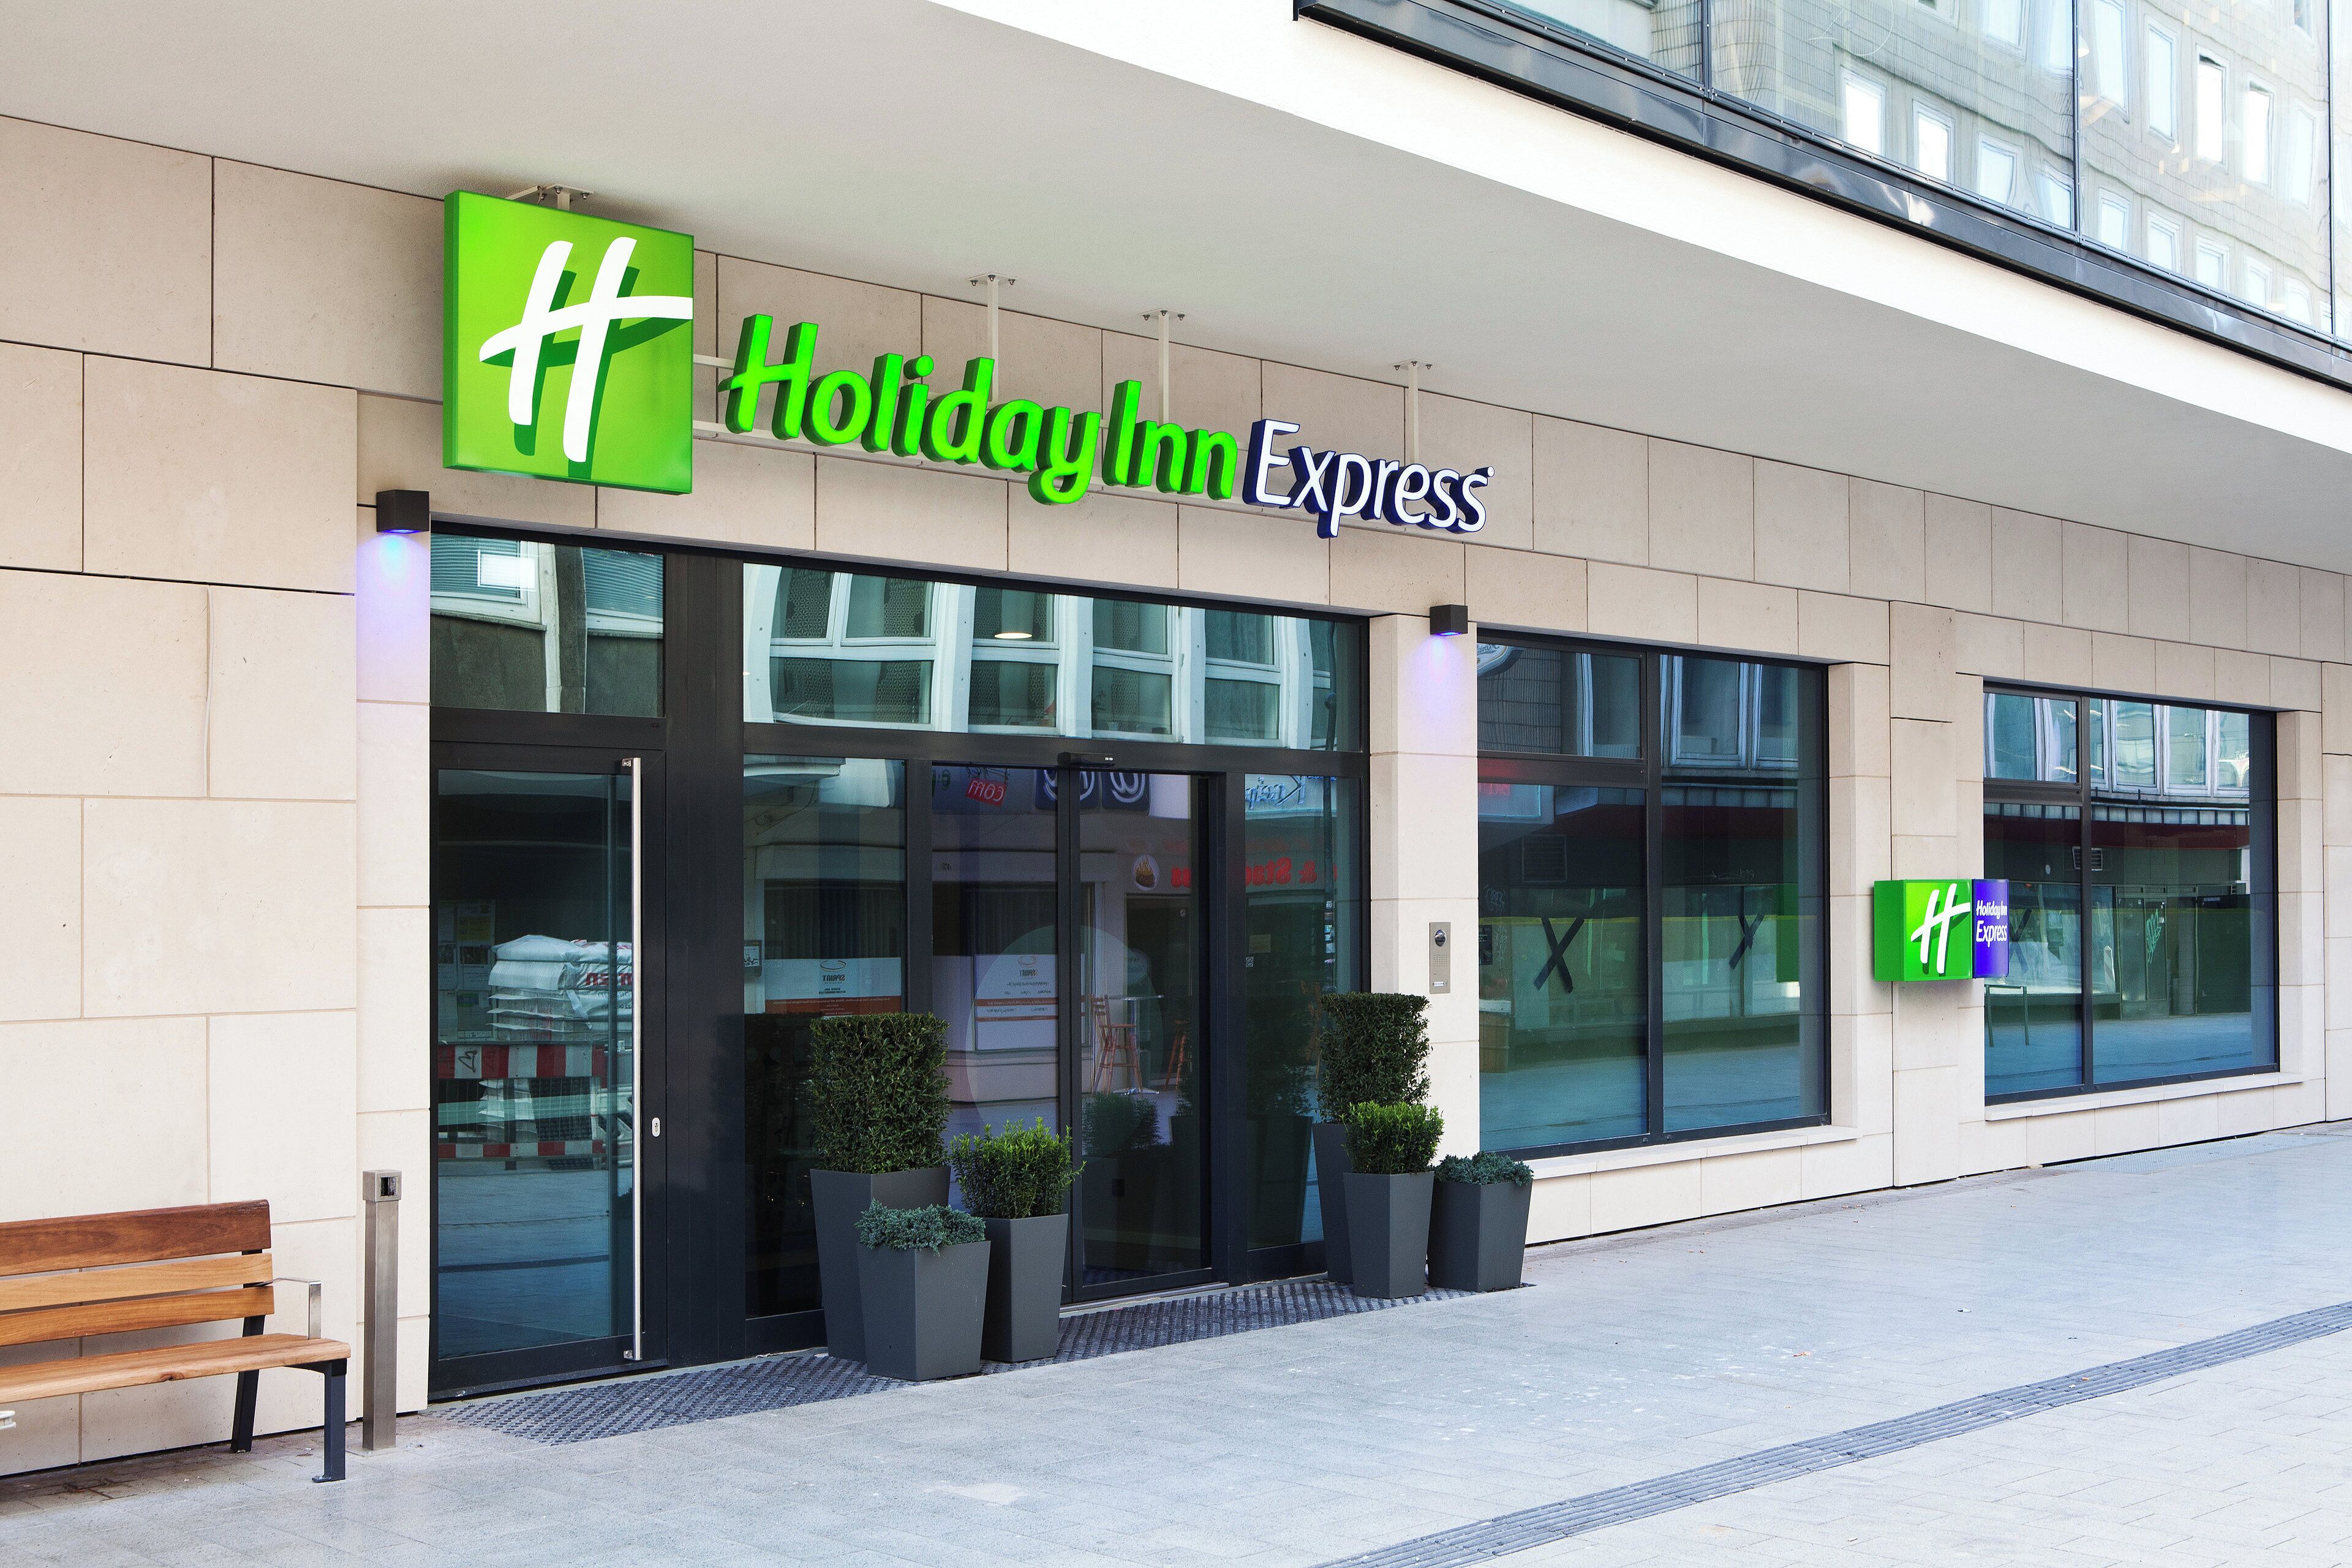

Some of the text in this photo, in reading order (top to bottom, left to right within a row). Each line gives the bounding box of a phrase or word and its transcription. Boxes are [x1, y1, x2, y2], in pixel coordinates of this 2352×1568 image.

[718, 314, 1490, 539] Holiday Inn Express
[1976, 900, 2001, 919] Holiday
[1975, 920, 2008, 948] Express
